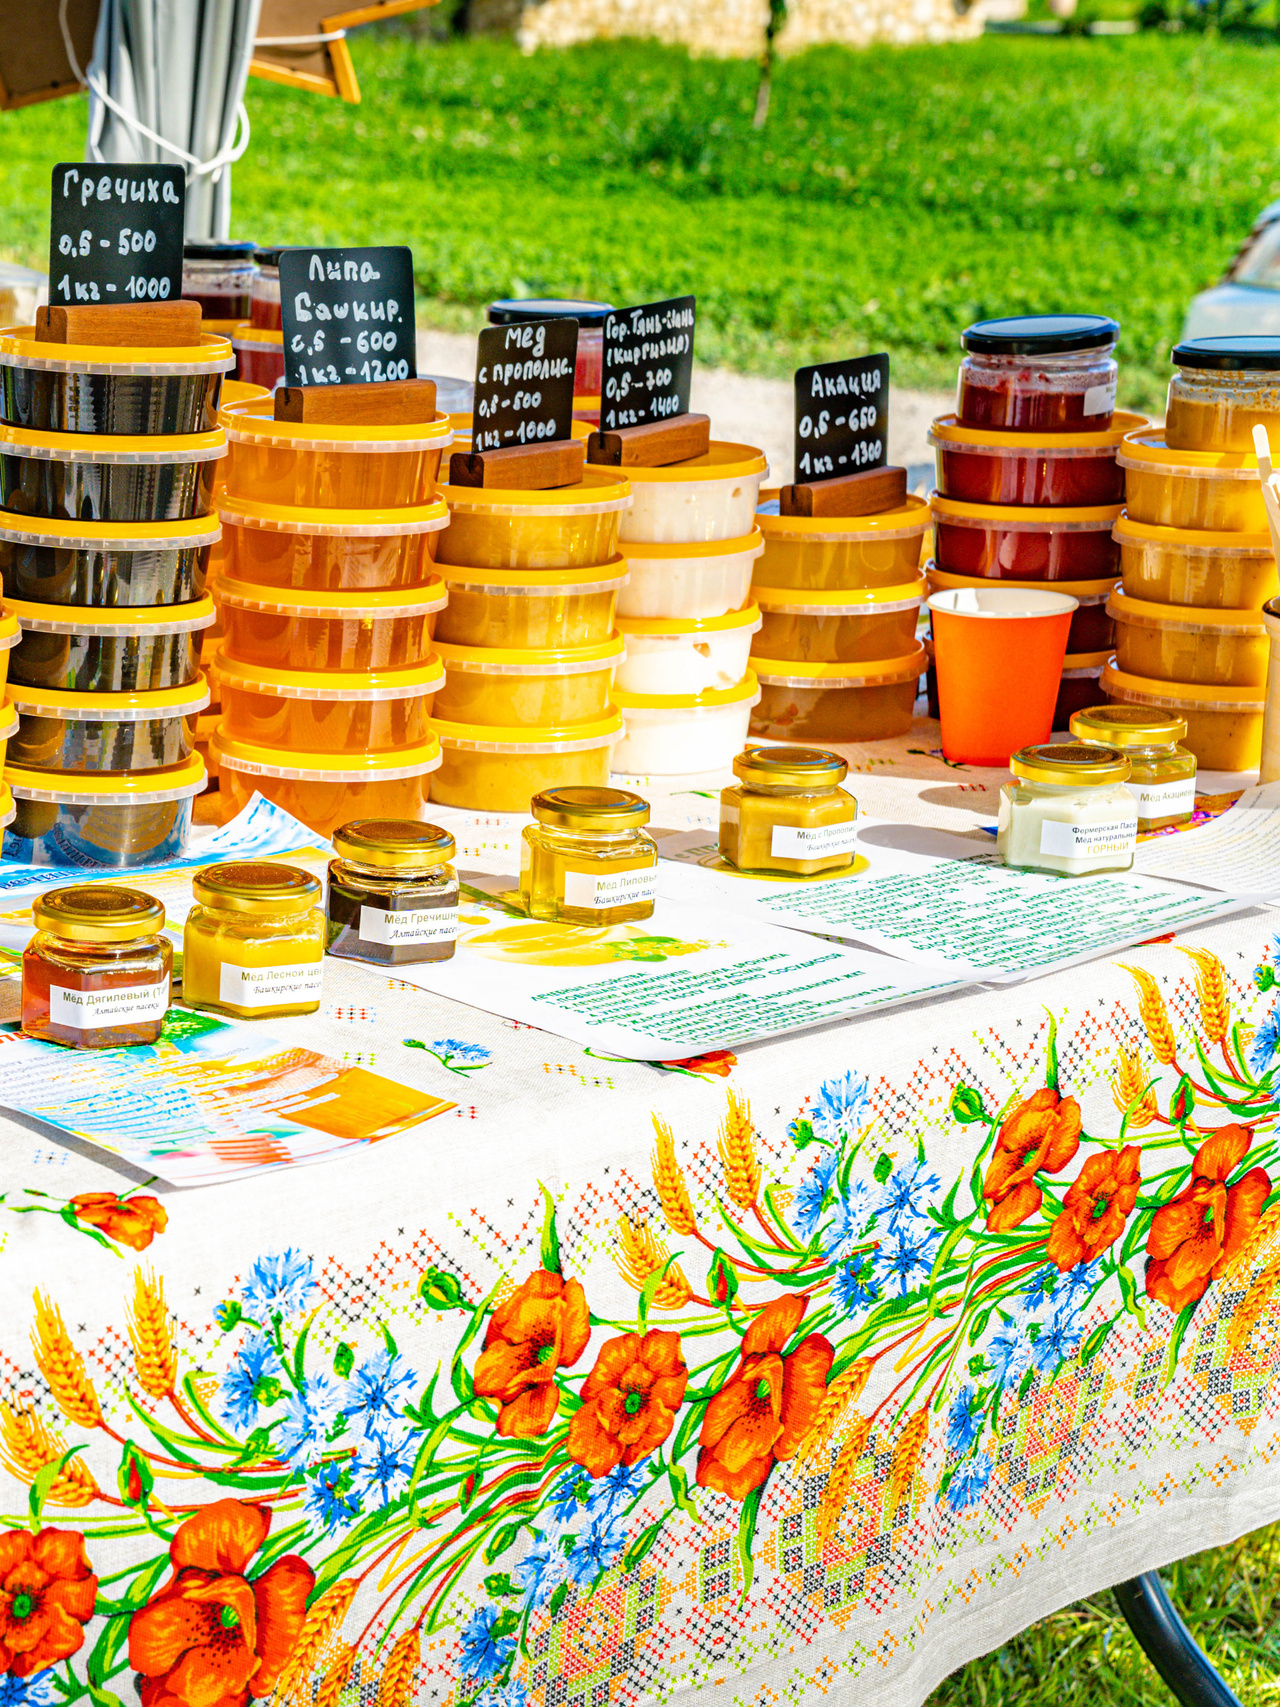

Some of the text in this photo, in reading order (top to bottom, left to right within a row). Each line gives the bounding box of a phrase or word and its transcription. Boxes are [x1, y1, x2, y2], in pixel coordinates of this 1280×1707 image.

[63, 168, 180, 207] Гречиха
[118, 227, 157, 256] 500
[309, 254, 381, 283] Липа
[124, 275, 171, 300] 1000
[356, 329, 398, 354] 600
[504, 325, 546, 358] Мед
[360, 358, 409, 383] 1200
[645, 368, 673, 391] 700
[811, 368, 881, 399] Акация
[512, 391, 542, 411] 500
[650, 394, 680, 418] 1400
[516, 418, 557, 444] 1000
[848, 405, 877, 432] 650
[850, 438, 882, 466] 1300
[62, 991, 84, 1006] Мёд
